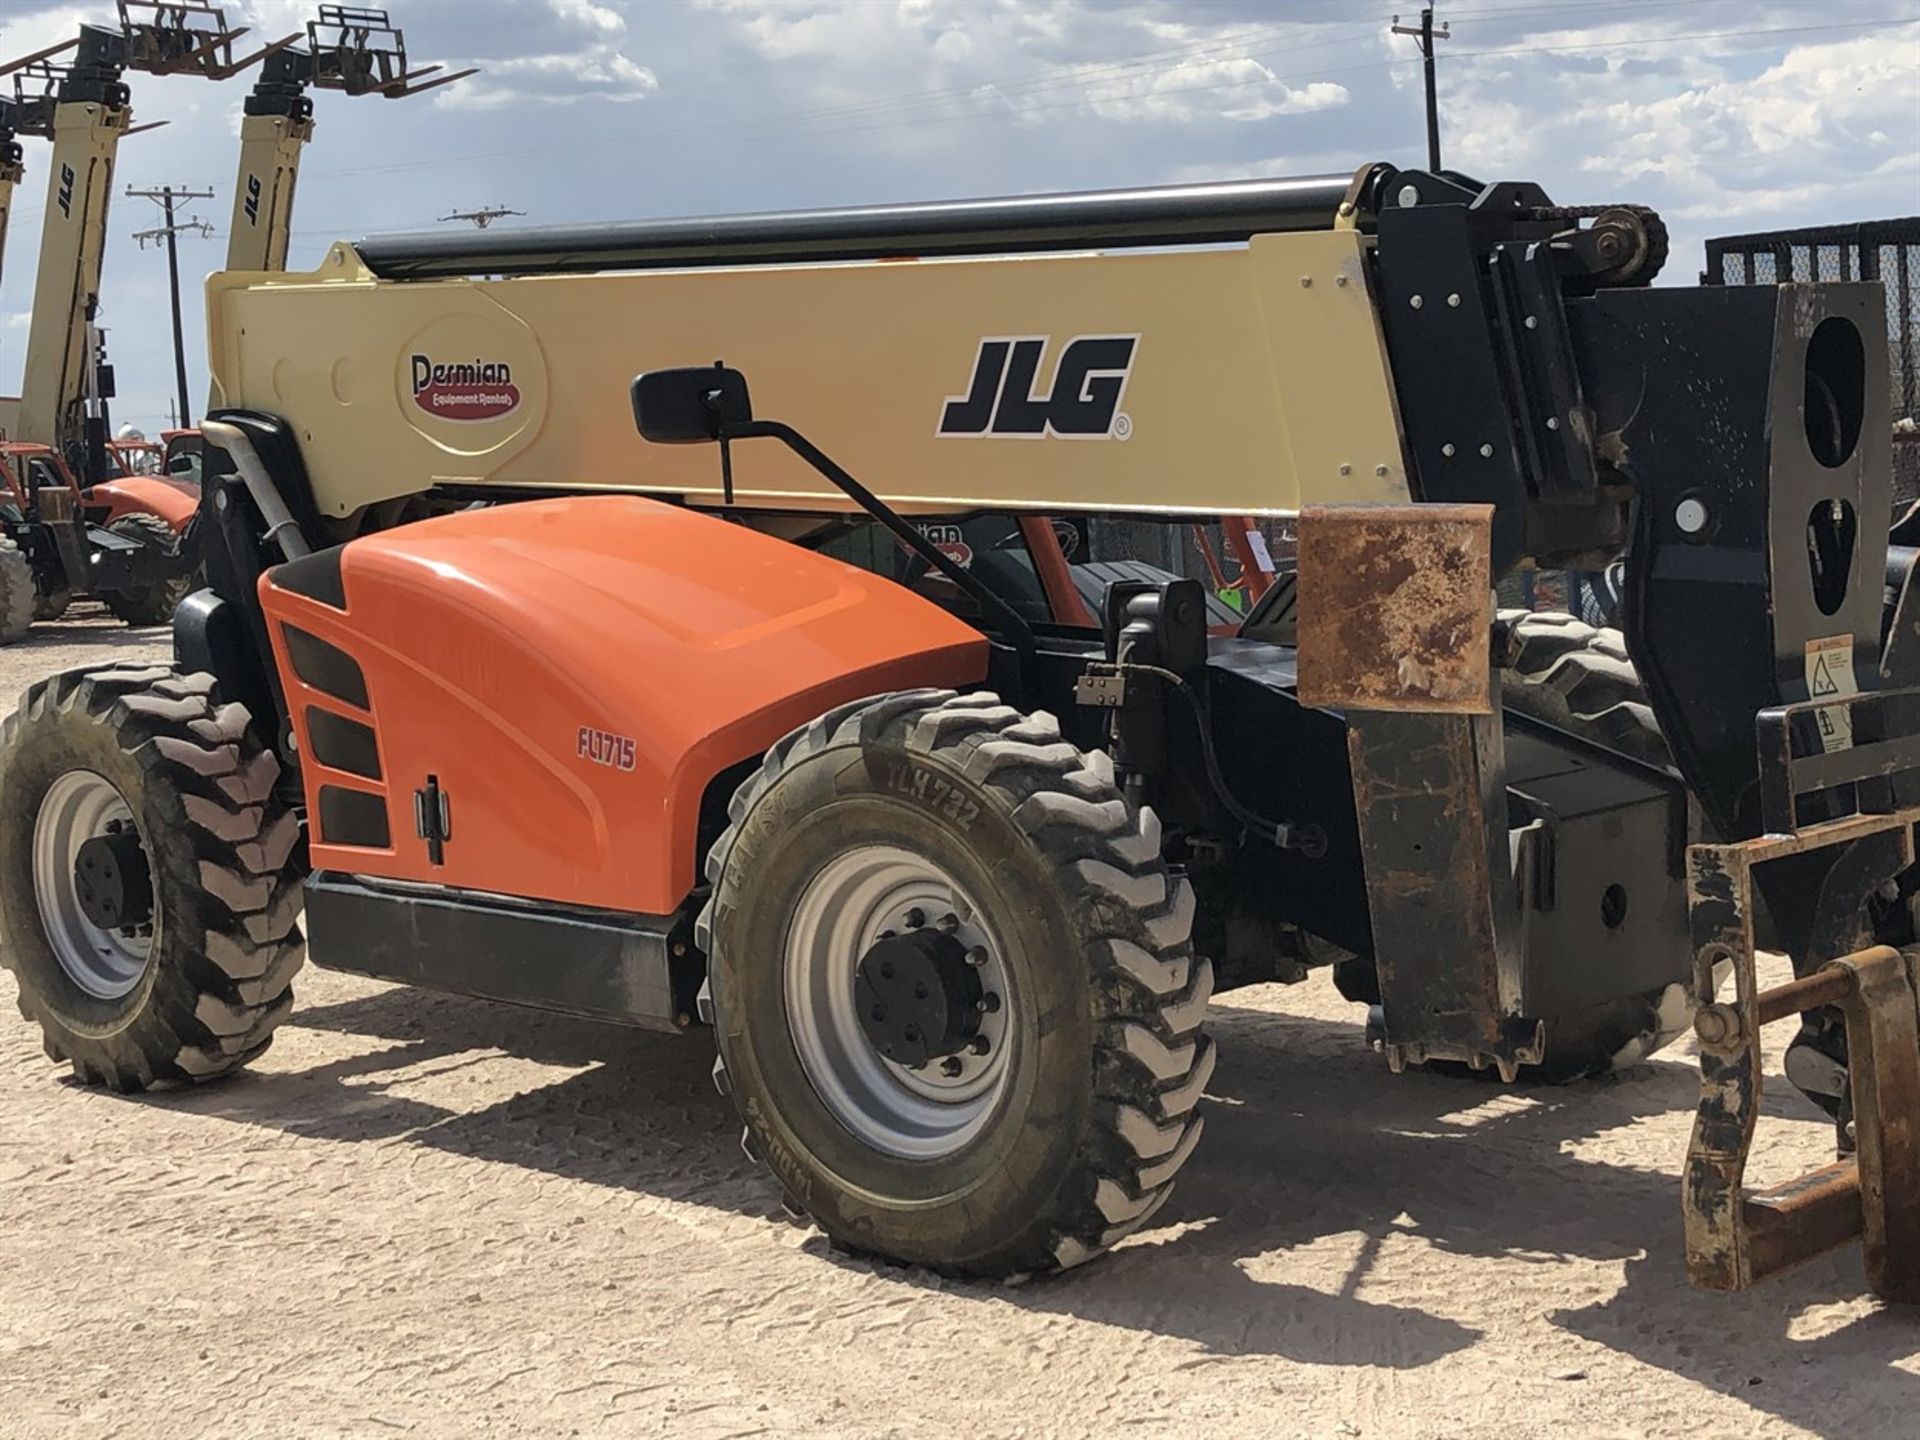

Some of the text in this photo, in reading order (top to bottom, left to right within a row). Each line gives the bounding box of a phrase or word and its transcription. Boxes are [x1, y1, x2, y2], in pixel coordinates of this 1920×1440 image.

[58, 161, 75, 221] JLG
[244, 172, 261, 228] JLG
[412, 354, 511, 395] Permian
[938, 337, 1137, 435] JLG
[432, 393, 513, 406] Equipment Rentals
[578, 727, 635, 770] FL1715
